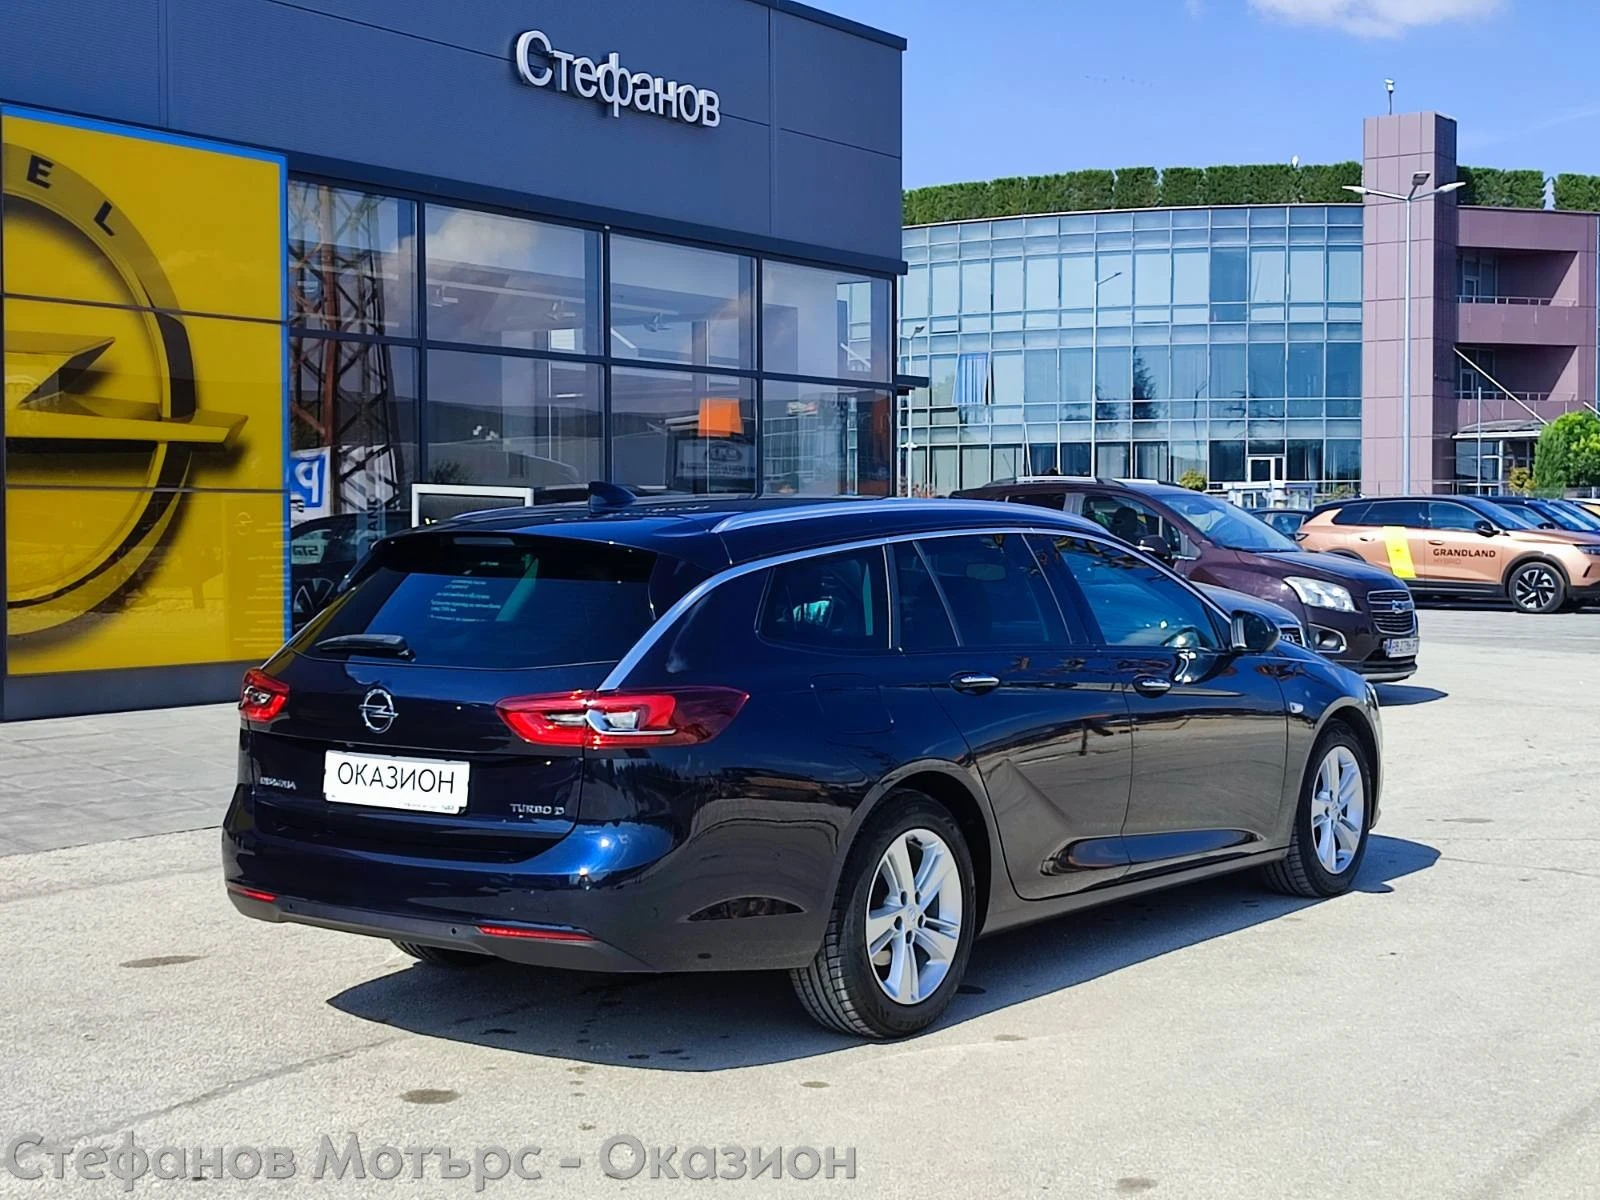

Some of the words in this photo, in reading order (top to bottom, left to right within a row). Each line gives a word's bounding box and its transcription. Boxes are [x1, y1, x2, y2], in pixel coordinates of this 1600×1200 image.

[516, 30, 720, 127] Стефанов
[1433, 548, 1496, 558] GRANDLAND
[338, 762, 454, 794] ОКАЗИОН
[510, 803, 552, 814] TURBO
